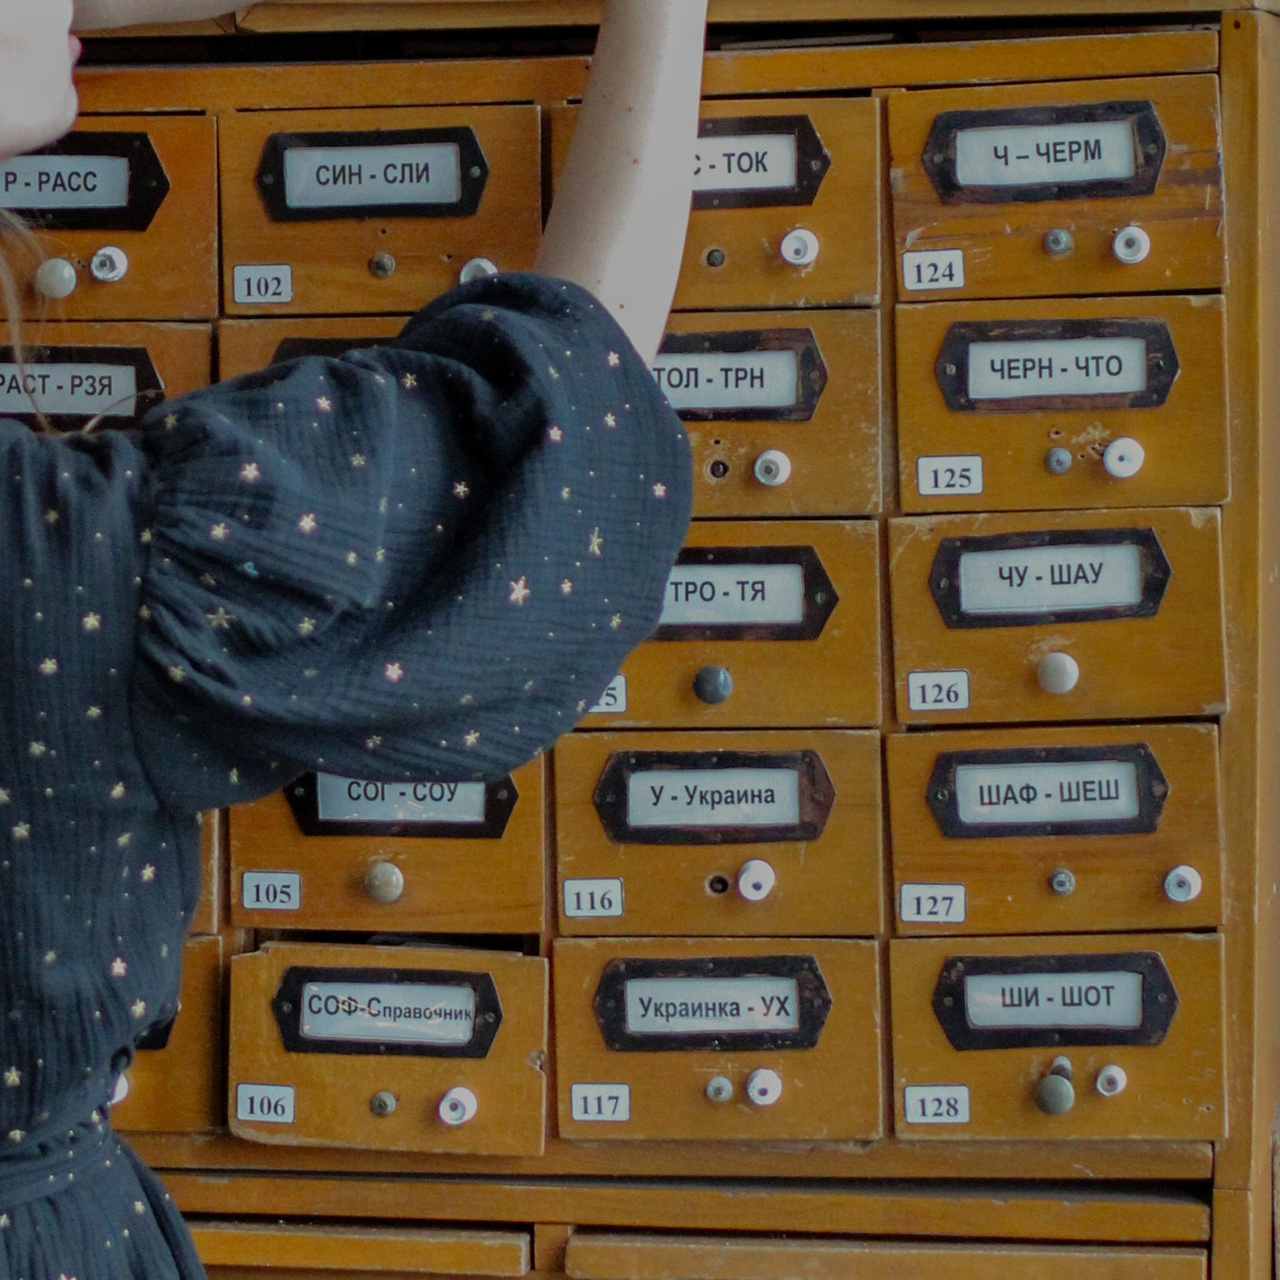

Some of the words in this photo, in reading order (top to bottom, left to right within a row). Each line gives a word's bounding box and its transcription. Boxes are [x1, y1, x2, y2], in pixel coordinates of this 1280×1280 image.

[994, 146, 1008, 166] Ч
[1036, 140, 1101, 163] ЧЕРМ
[39, 171, 96, 192] РАСС
[316, 165, 362, 185] СИН
[384, 163, 429, 184] СЛИ
[916, 262, 954, 283] 124
[246, 277, 281, 296] 102
[991, 358, 1052, 379] ЧЕРН
[1076, 356, 1122, 377] ЧТО
[71, 375, 111, 395] РЗЯ
[933, 468, 971, 488] 125
[999, 566, 1027, 587] ЧУ
[1051, 563, 1103, 585] ШАУ
[671, 581, 715, 602] ТРО
[737, 581, 765, 601] ТЯ
[921, 684, 958, 703] 126
[651, 786, 663, 806] У
[685, 786, 775, 810] Украина
[980, 784, 1037, 805] ШАФ
[1060, 780, 1119, 802] ШЕШ
[255, 884, 291, 903] 105
[576, 892, 612, 910] 116
[916, 896, 953, 915] 127
[1002, 988, 1039, 1007] ШИ
[1062, 986, 1114, 1006] ШОТ
[639, 997, 740, 1022] Украинка
[761, 996, 790, 1016] УХ
[249, 1096, 285, 1115] 106
[583, 1096, 619, 1114] 117
[920, 1098, 958, 1116] 128
